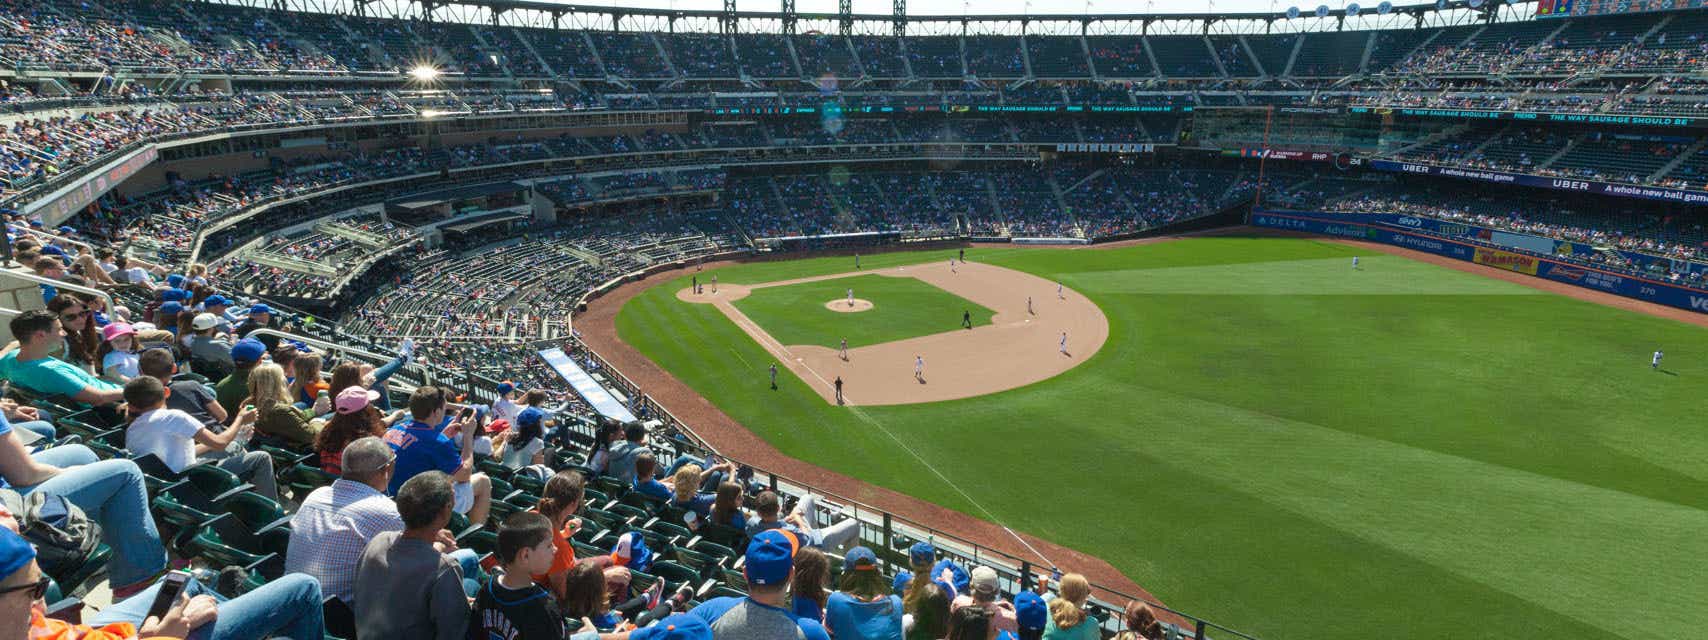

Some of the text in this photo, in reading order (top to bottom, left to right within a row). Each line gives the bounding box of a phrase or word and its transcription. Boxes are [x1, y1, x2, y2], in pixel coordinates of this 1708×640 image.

[1631, 117, 1671, 125] SHOULD
[1673, 118, 1688, 126] BE
[1402, 164, 1429, 173] UBER
[1481, 172, 1494, 180] ball
[1552, 179, 1590, 191] UBER
[1605, 184, 1613, 192] A
[1613, 186, 1641, 195] whole
[1642, 189, 1663, 198] new
[1664, 190, 1683, 200] ball
